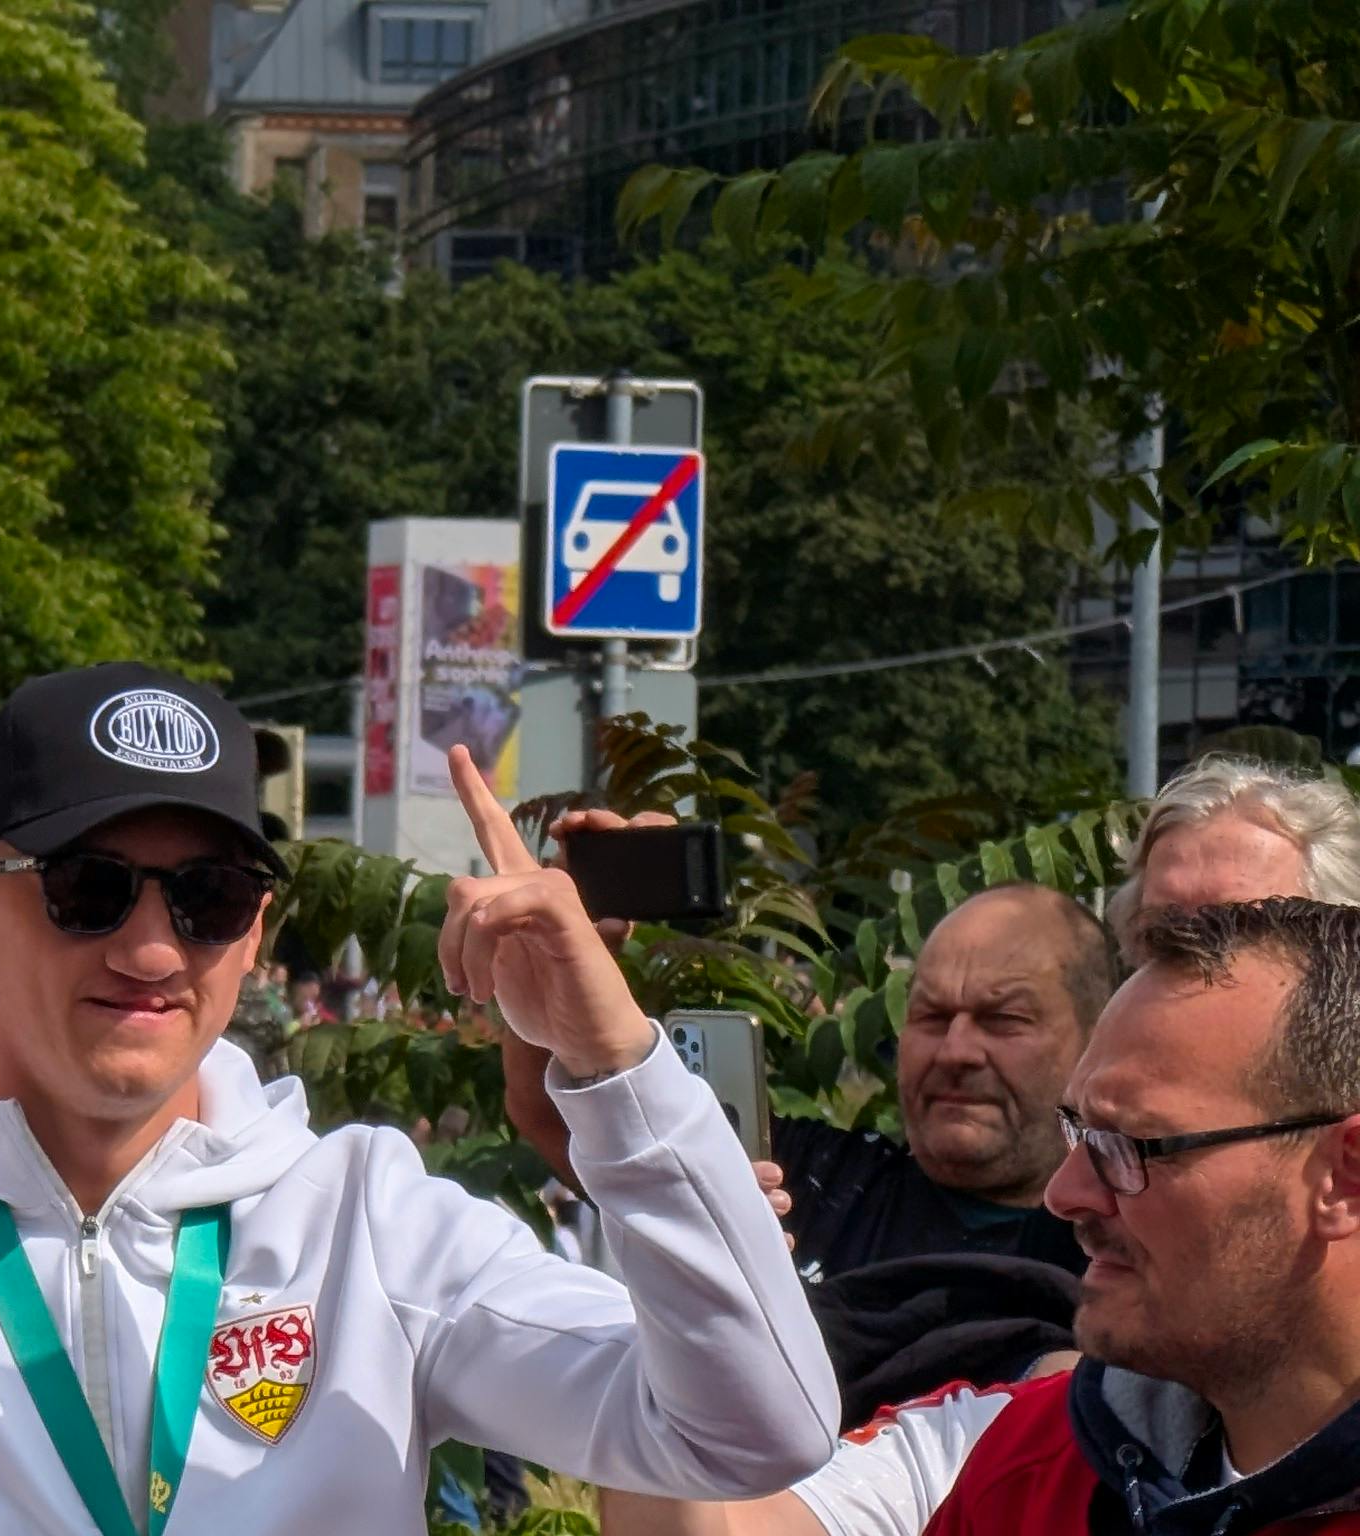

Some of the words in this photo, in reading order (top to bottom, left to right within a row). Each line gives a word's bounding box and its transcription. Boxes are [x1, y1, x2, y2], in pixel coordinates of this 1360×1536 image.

[118, 704, 201, 754] BUXTON
[113, 746, 205, 769] ESSENTIALISM
[233, 1379, 247, 1390] 18
[279, 1370, 295, 1382] 93
